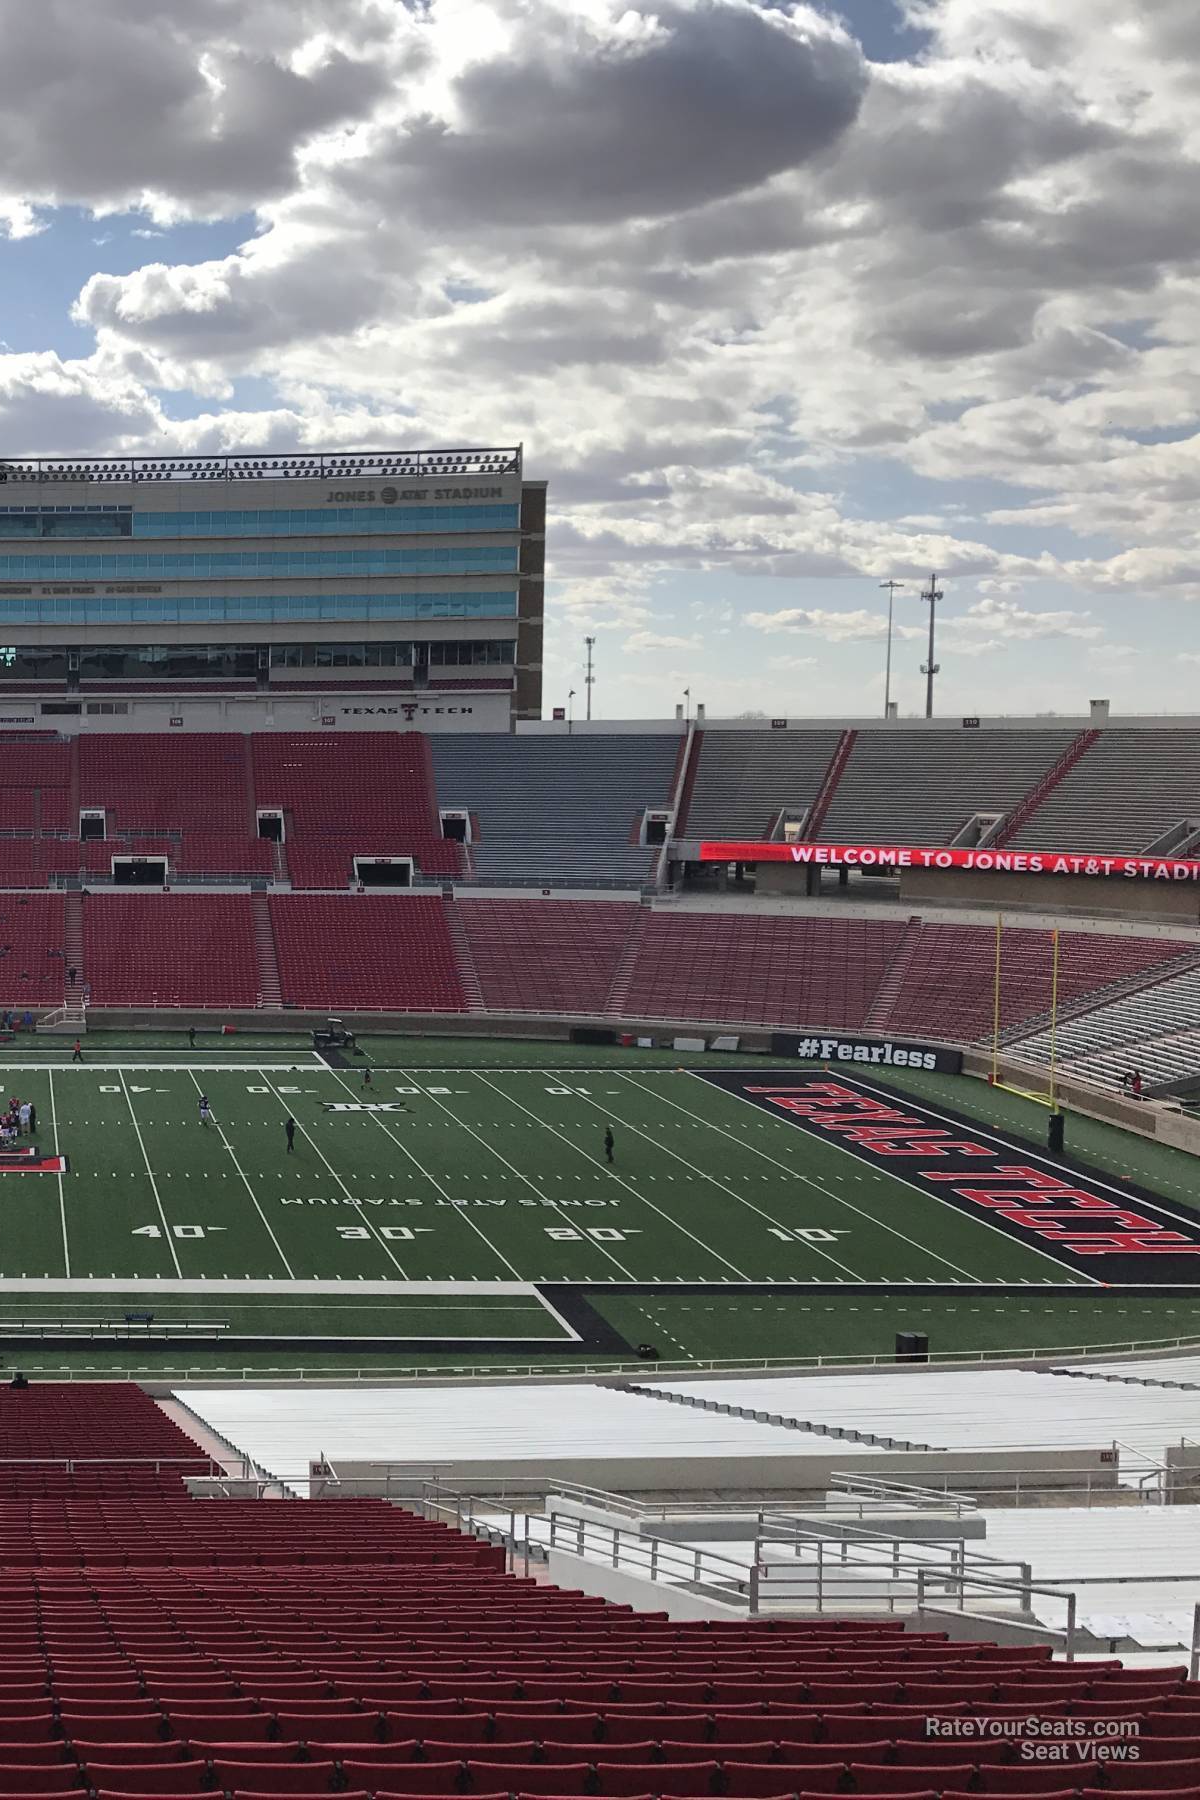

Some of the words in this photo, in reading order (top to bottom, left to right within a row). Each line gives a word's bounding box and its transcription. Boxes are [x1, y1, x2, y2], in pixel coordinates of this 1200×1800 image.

[326, 490, 376, 503] JONES
[434, 487, 503, 500] STADIUM
[341, 707, 398, 715] TEXAS
[791, 847, 911, 866] WELCOME
[920, 851, 952, 868] TO
[961, 853, 1043, 872] JONES
[1052, 857, 1115, 876] AT&T
[797, 1038, 937, 1070] #Fearless
[99, 1085, 151, 1094] 40
[743, 1082, 999, 1156] TEXAS
[917, 1165, 1200, 1255] TECH
[280, 1198, 424, 1206] STADIUM
[519, 1199, 622, 1207] JONES
[131, 1225, 206, 1238] 40
[335, 1226, 416, 1239] 30
[543, 1227, 626, 1241] 20
[767, 1228, 839, 1241] 10
